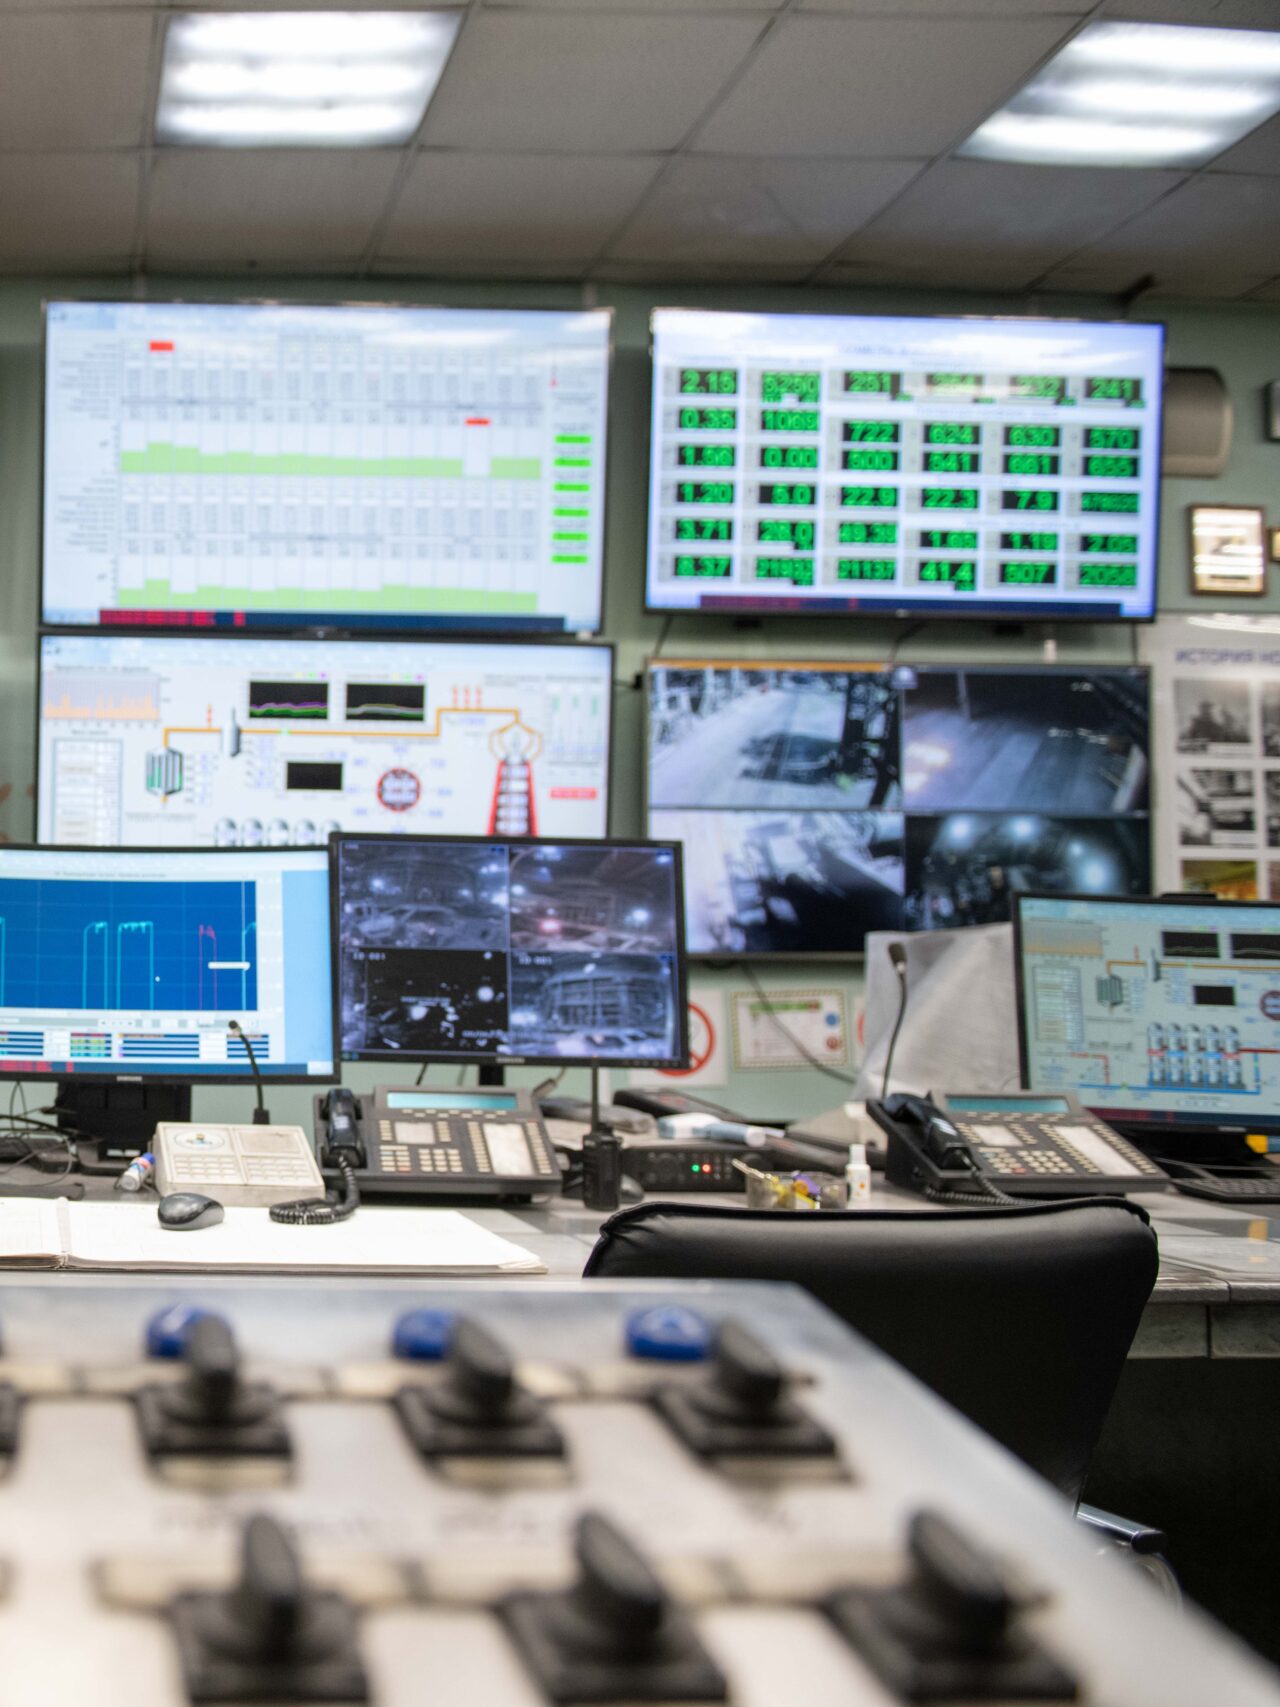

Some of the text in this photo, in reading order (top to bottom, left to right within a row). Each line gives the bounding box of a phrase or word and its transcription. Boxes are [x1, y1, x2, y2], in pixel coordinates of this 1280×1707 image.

[849, 422, 894, 442] 722
[764, 447, 817, 467] 0.00
[681, 483, 732, 503] 1.20
